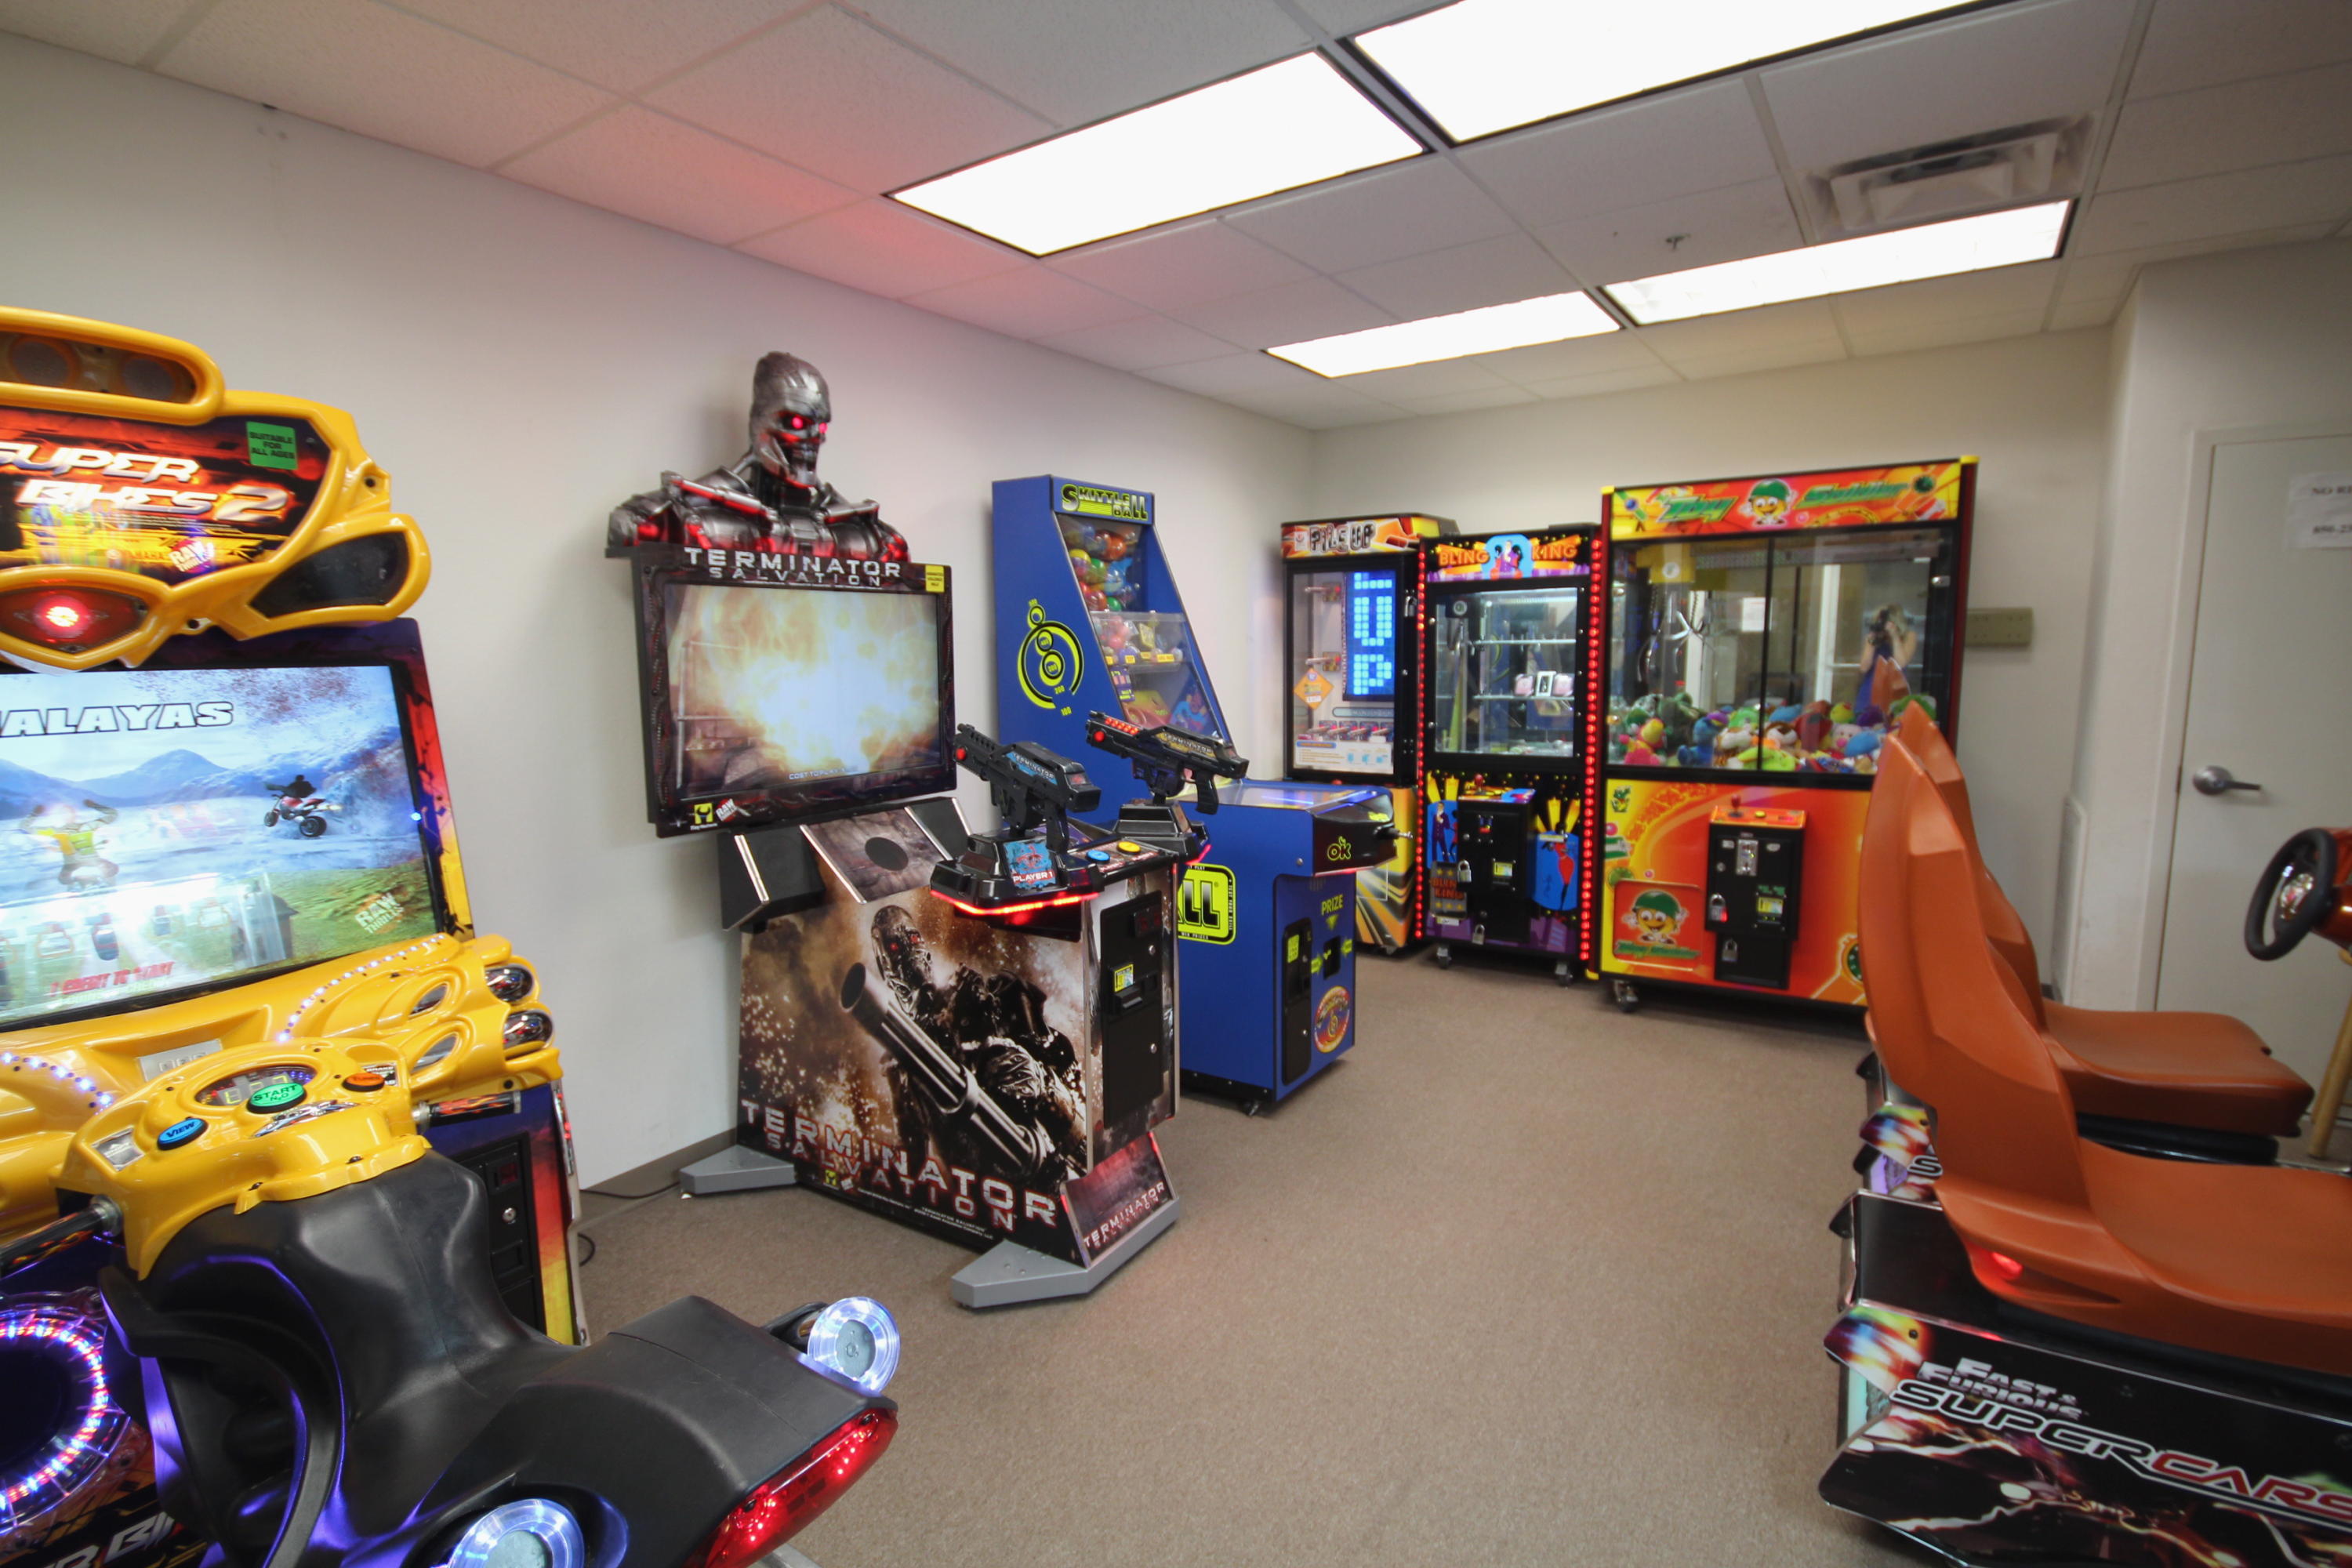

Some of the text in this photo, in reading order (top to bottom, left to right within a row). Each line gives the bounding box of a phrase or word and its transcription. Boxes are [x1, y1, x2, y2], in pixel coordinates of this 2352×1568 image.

[250, 431, 292, 444] SUITABLE
[263, 441, 282, 449] FOR
[251, 447, 268, 456] ALL
[14, 479, 220, 516] BIKES
[212, 484, 289, 524] 2
[1062, 484, 1130, 511] SKITTLE
[1112, 495, 1149, 521] BALL
[1309, 520, 1376, 554] PILE UP
[684, 546, 901, 578] TERMINATOR
[1439, 543, 1578, 567] BLING KING
[709, 567, 881, 586] SALVATION
[0, 701, 234, 738] ALAYAS
[1061, 706, 1072, 716] 100
[1013, 870, 1054, 883] PLAYER 1
[354, 892, 401, 927] RAW
[1178, 878, 1221, 931] LL
[1321, 895, 1344, 916] PRIZE
[254, 1084, 298, 1102] START
[166, 1121, 196, 1138] VIEW
[740, 1098, 1058, 1228] TERMINATOR
[766, 1131, 1014, 1232] SALVATION
[1083, 1181, 1165, 1248] TERMINATOR
[1916, 1360, 2083, 1421] FURIOUS
[1955, 1357, 2057, 1398] FAST
